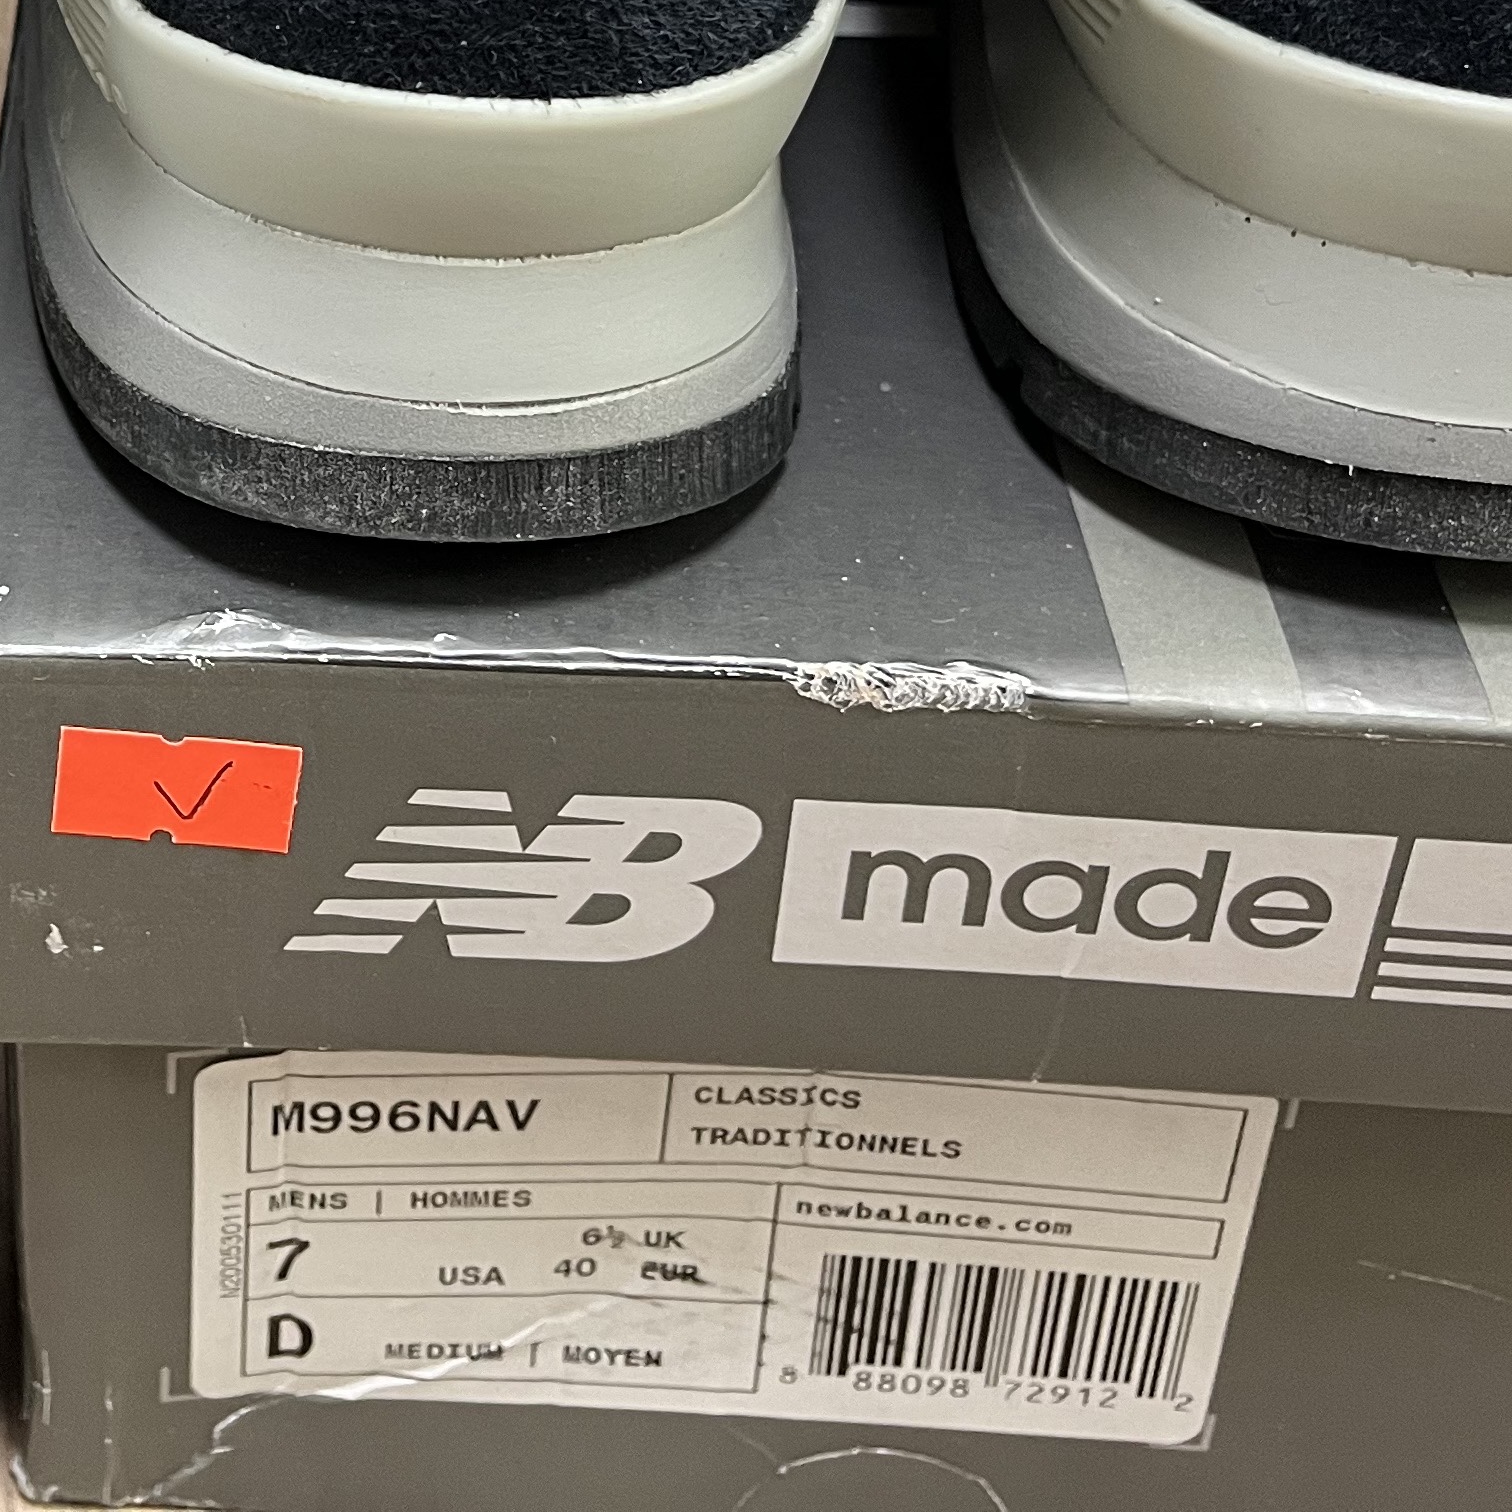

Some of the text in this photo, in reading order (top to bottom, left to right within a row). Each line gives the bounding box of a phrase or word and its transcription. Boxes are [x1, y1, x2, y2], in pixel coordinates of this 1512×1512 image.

[284, 788, 1332, 963] NB made
[694, 1085, 862, 1110] CLASSICS
[271, 1098, 541, 1136] M996NAV
[690, 1125, 963, 1160] TRADITIONNELS
[268, 1189, 533, 1212] MENS HOMMES
[796, 1196, 1073, 1237] newbalance.com
[643, 1229, 687, 1250] UK
[266, 1237, 310, 1282] 7
[438, 1266, 506, 1288] USA
[553, 1257, 597, 1279] 40
[266, 1314, 314, 1359] D
[385, 1342, 663, 1368] MEDIUM MOYEN
[778, 1367, 1195, 1414] 8 88098 72912 2
